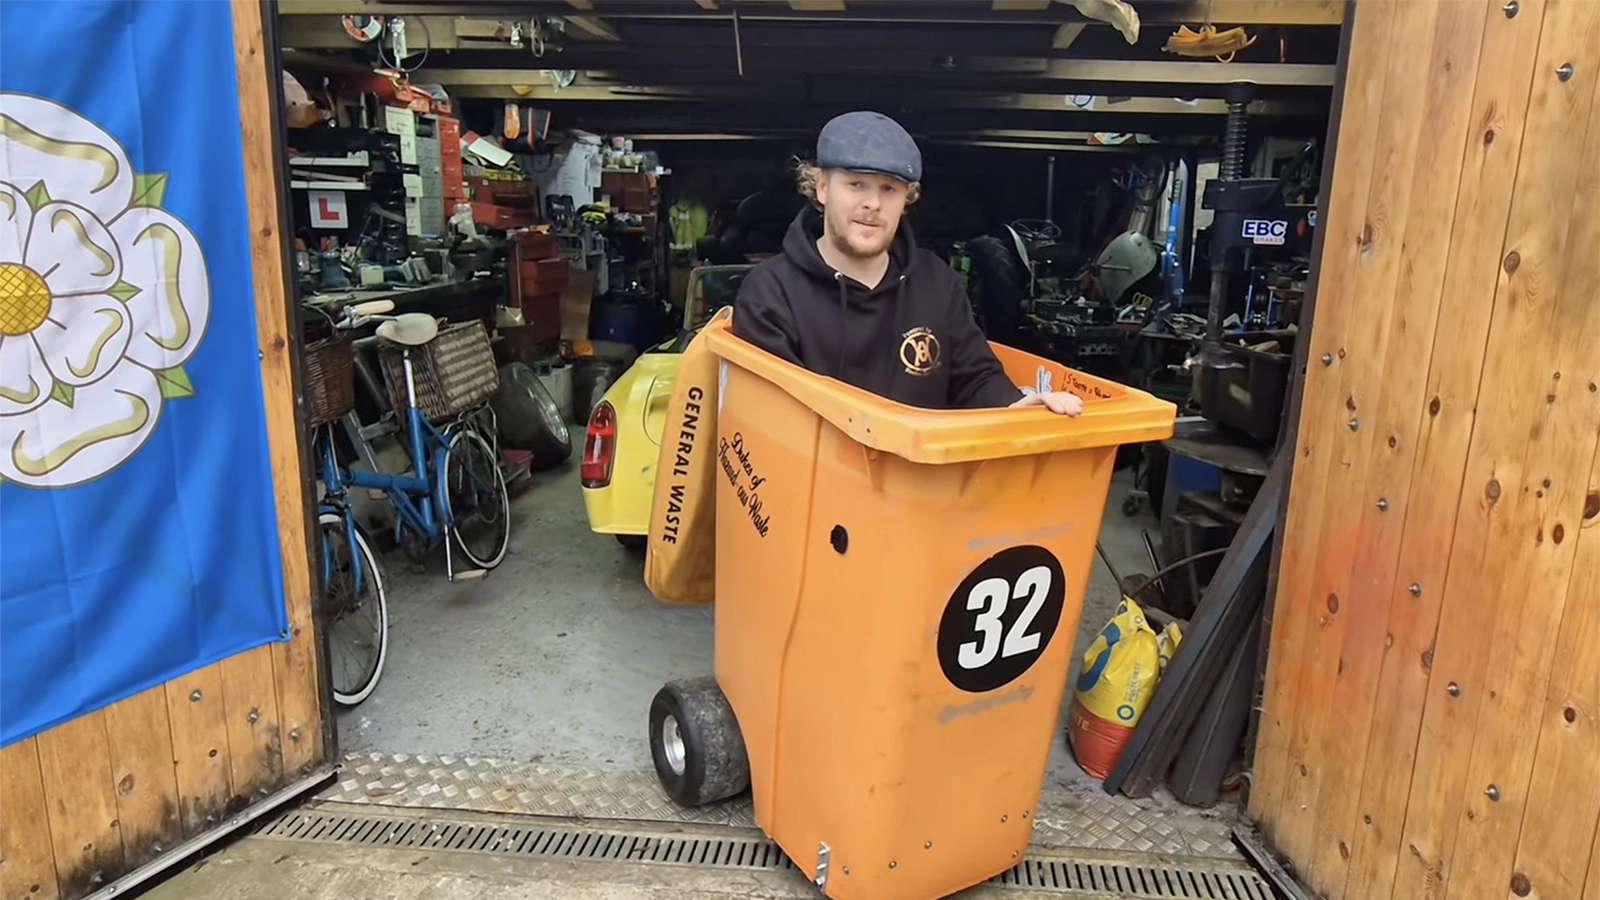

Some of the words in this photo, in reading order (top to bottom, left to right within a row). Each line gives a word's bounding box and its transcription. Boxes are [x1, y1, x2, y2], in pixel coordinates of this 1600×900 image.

[318, 198, 340, 220] L
[1243, 221, 1286, 237] EBC
[673, 386, 704, 477] GENERAL
[731, 431, 754, 477] Dukes
[748, 475, 767, 491] of
[662, 485, 686, 545] WASTE
[748, 493, 770, 538] Waste
[957, 565, 1052, 670] 32
